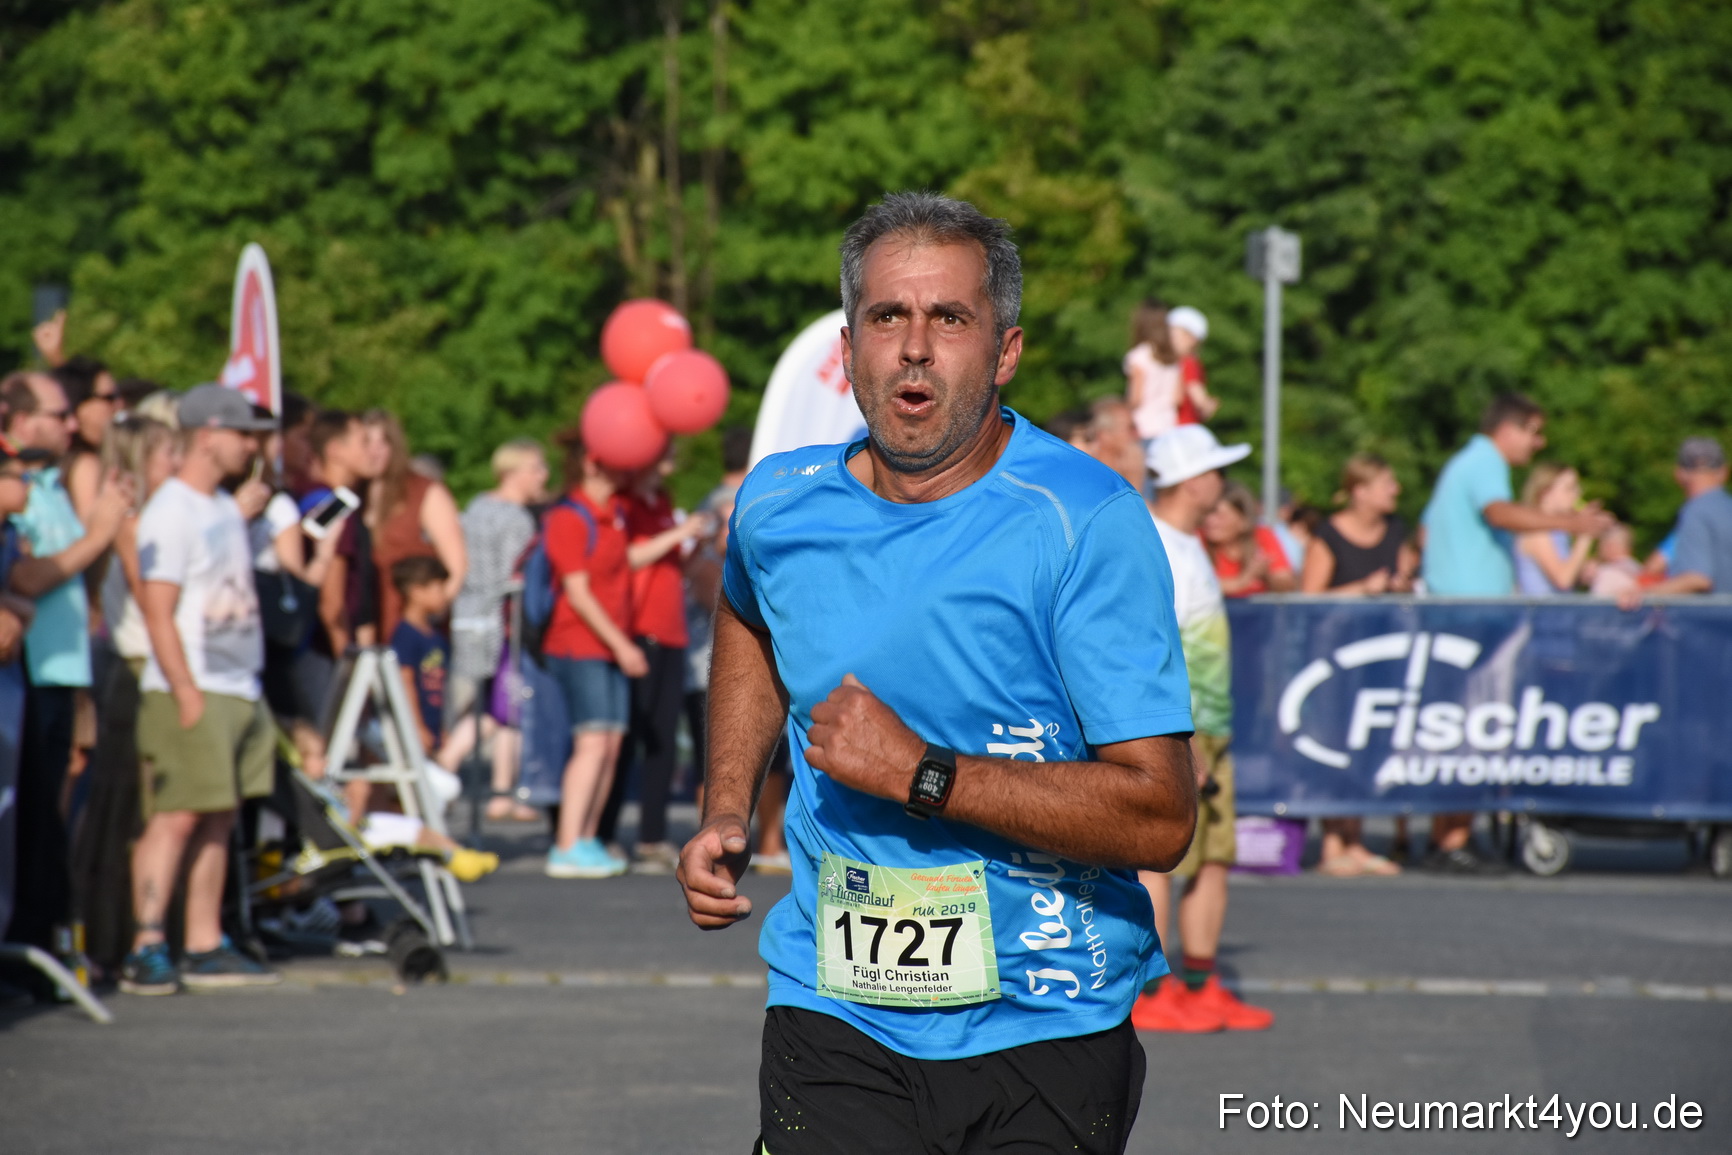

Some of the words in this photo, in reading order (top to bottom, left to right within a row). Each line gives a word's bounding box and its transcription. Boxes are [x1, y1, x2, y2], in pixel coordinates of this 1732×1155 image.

[1347, 686, 1662, 752] Fischer
[1378, 755, 1634, 786] AUTOMOBILE
[910, 872, 944, 883] Gesunde
[836, 885, 895, 908] firmenlauf
[912, 905, 935, 916] run
[941, 902, 976, 916] 2019
[835, 911, 963, 967] 1727
[853, 965, 881, 982] Fügl
[885, 969, 949, 981] Christian
[852, 980, 887, 992] Nathalie
[889, 983, 953, 995] Lengenfelder
